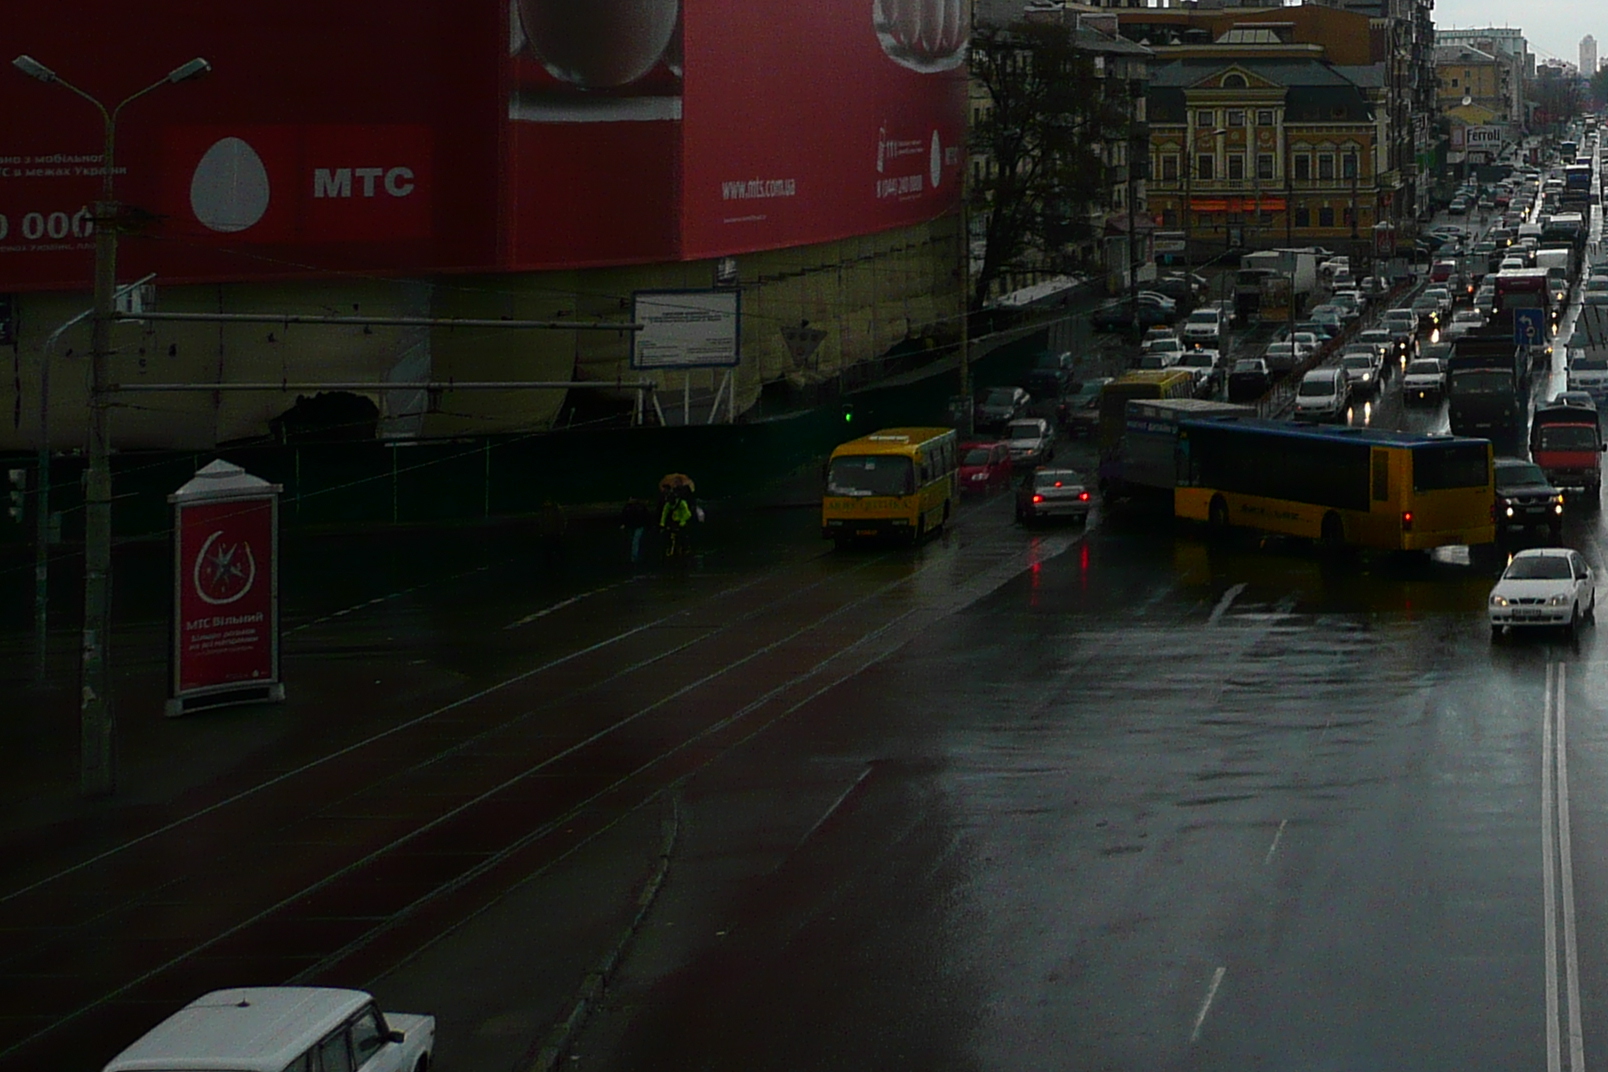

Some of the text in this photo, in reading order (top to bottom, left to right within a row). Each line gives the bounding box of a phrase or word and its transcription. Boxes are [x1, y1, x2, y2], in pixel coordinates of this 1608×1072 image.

[1467, 129, 1500, 143] Ferroli
[74, 166, 128, 177] Украни
[313, 166, 415, 199] МТС
[721, 175, 796, 201] www.mts.com.ua
[187, 612, 263, 630] МТС Вільний
